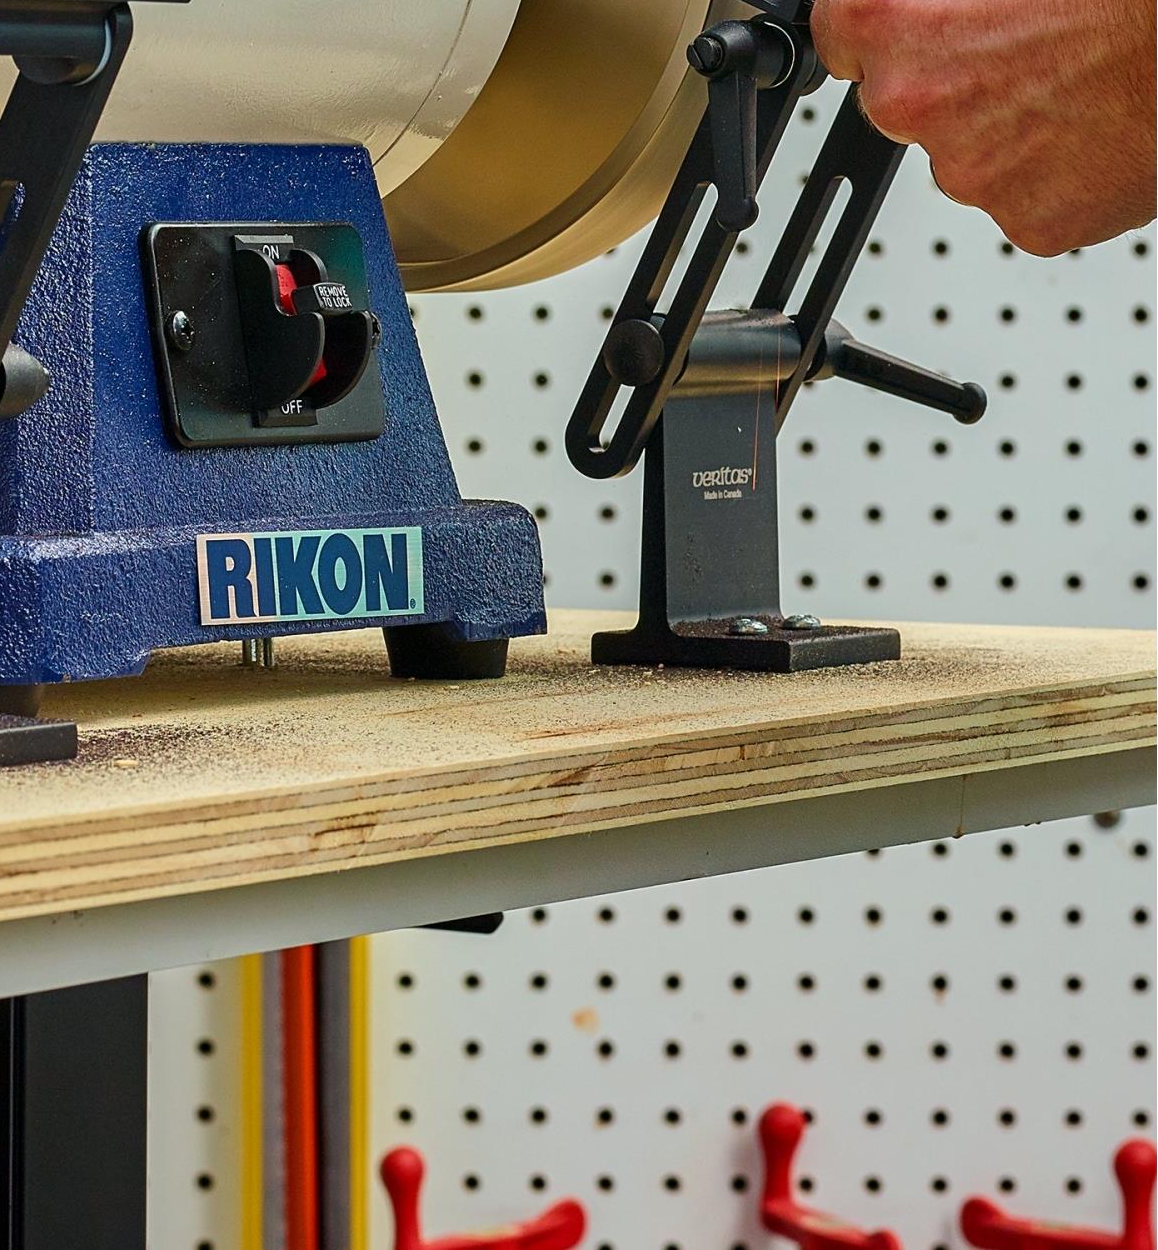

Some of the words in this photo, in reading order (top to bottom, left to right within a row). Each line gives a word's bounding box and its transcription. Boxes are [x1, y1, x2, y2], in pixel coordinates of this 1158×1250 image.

[318, 285, 349, 297] REMOVE
[322, 296, 333, 308] TO
[332, 296, 353, 308] LOCK
[281, 400, 303, 415] OFF
[704, 491, 718, 500] Made
[718, 490, 724, 499] in
[724, 489, 743, 499] Canada
[205, 532, 416, 620] RIKON
